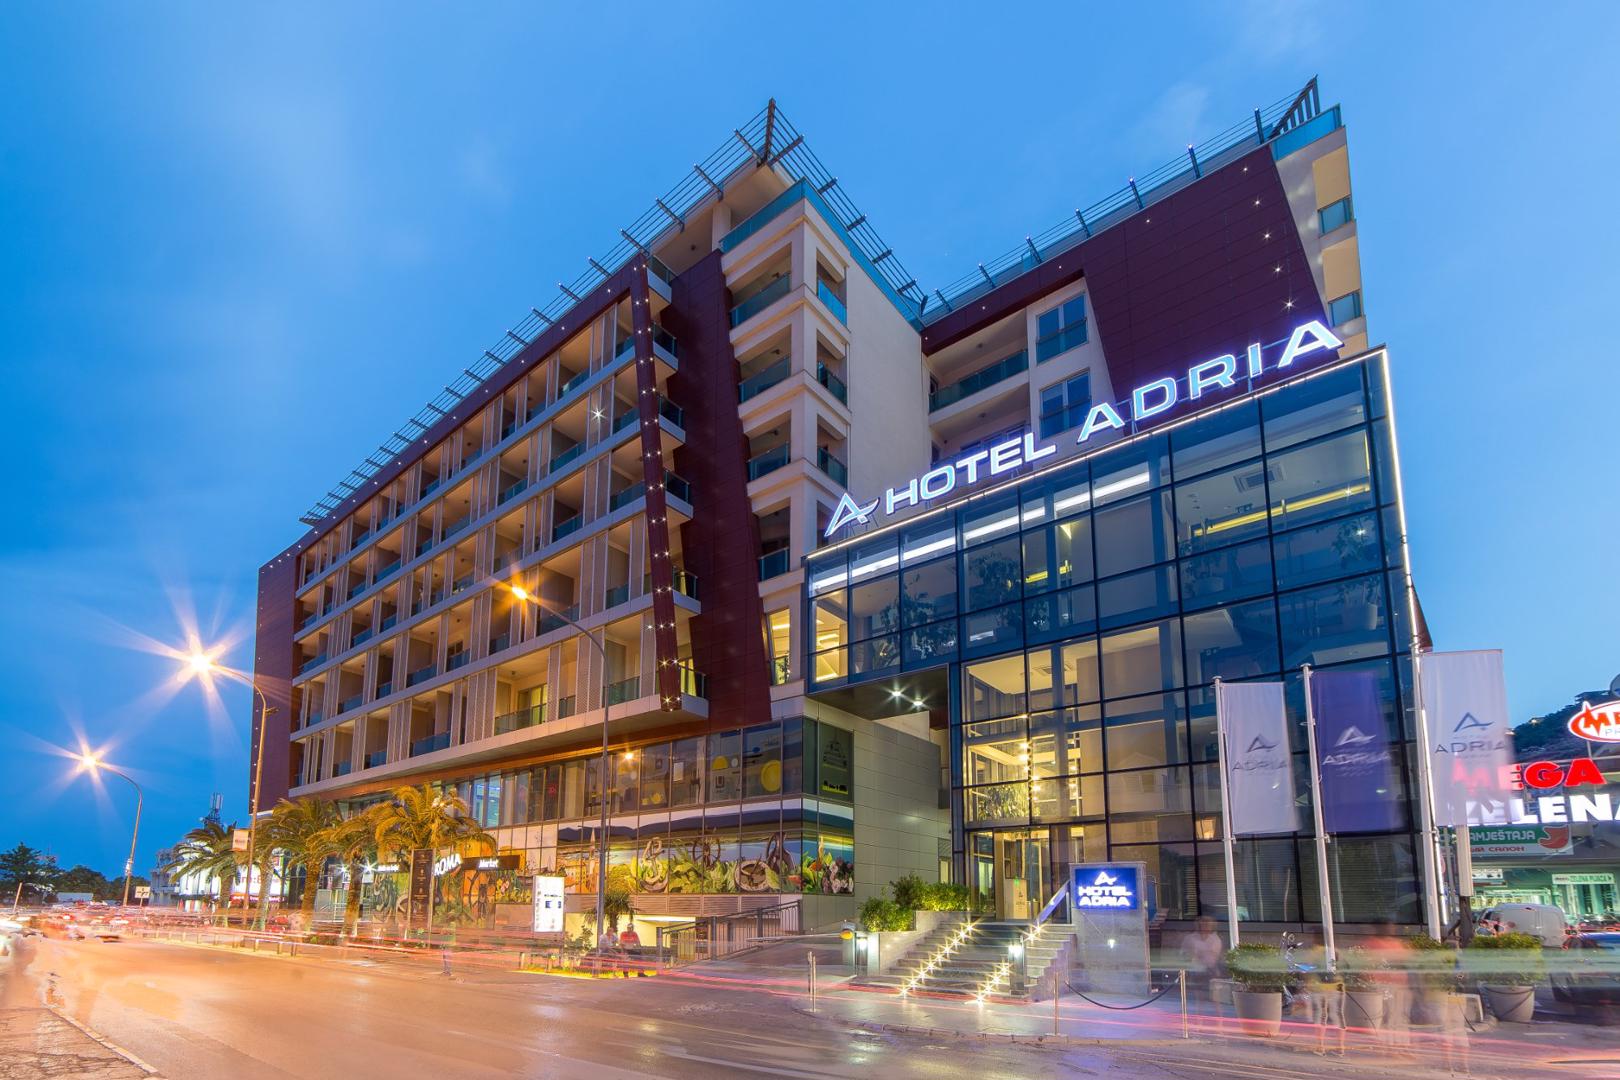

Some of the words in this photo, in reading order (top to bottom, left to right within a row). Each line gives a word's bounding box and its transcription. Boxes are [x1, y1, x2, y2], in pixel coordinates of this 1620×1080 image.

[885, 432, 1057, 515] HOTEL
[1077, 319, 1345, 443] ADRIA
[1435, 741, 1505, 753] ADRIA
[1452, 755, 1608, 798] MEGA
[1448, 793, 1620, 827] ZELEN
[1469, 829, 1536, 842] AMJEŠTAJA
[434, 852, 463, 877] ROMA
[1078, 886, 1133, 896] HOTEL
[1079, 896, 1131, 906] ADRIA
